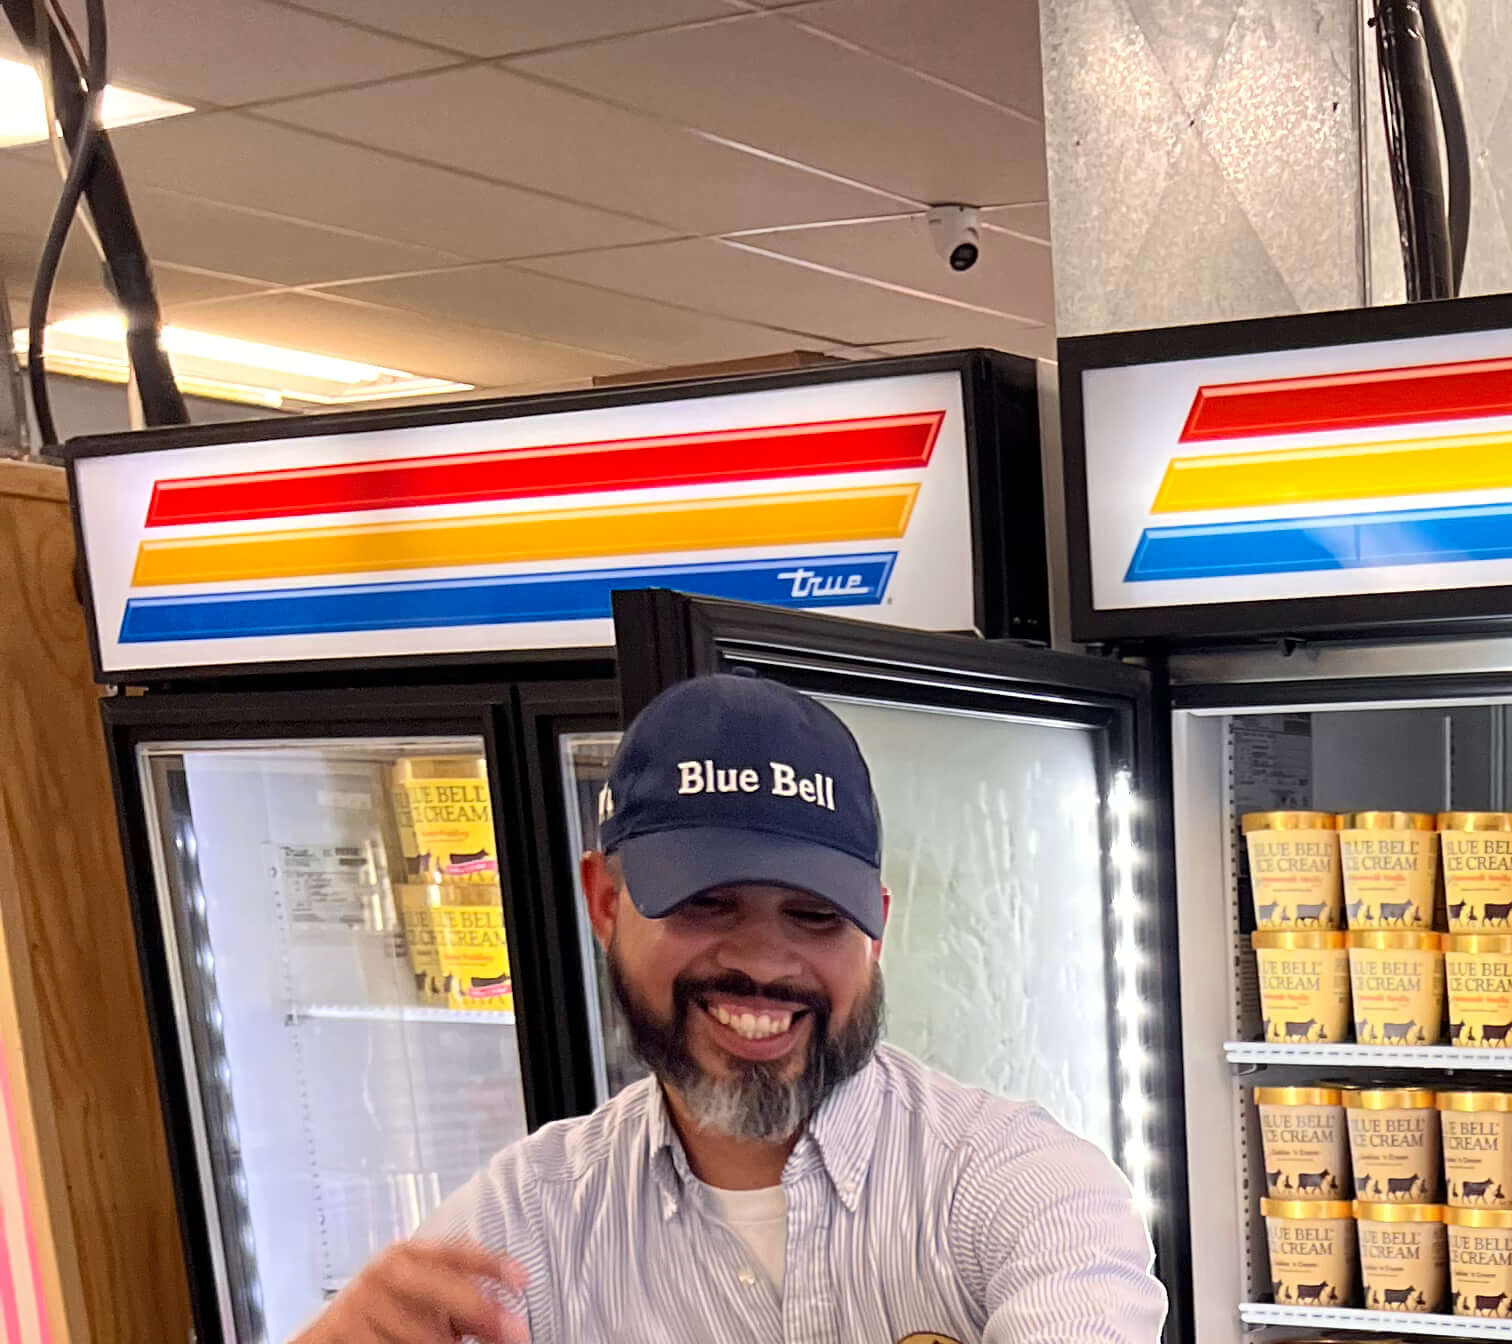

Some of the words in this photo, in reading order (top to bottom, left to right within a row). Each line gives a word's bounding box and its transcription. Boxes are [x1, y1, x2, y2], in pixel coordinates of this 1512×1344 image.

[778, 569, 870, 600] true
[677, 760, 760, 797] Blue
[769, 761, 837, 813] Bell
[1276, 858, 1332, 873] CREAM
[1361, 856, 1417, 871] CREAM
[1367, 977, 1421, 992] CREAM
[1460, 1122, 1499, 1136] BELL
[1281, 1130, 1335, 1144] CREAM
[1369, 1134, 1424, 1148] CREAM
[1295, 1228, 1334, 1241] BELL
[1381, 1231, 1421, 1245] BELL
[1281, 1242, 1333, 1256] CREAM
[1462, 1252, 1512, 1266] CREAM
